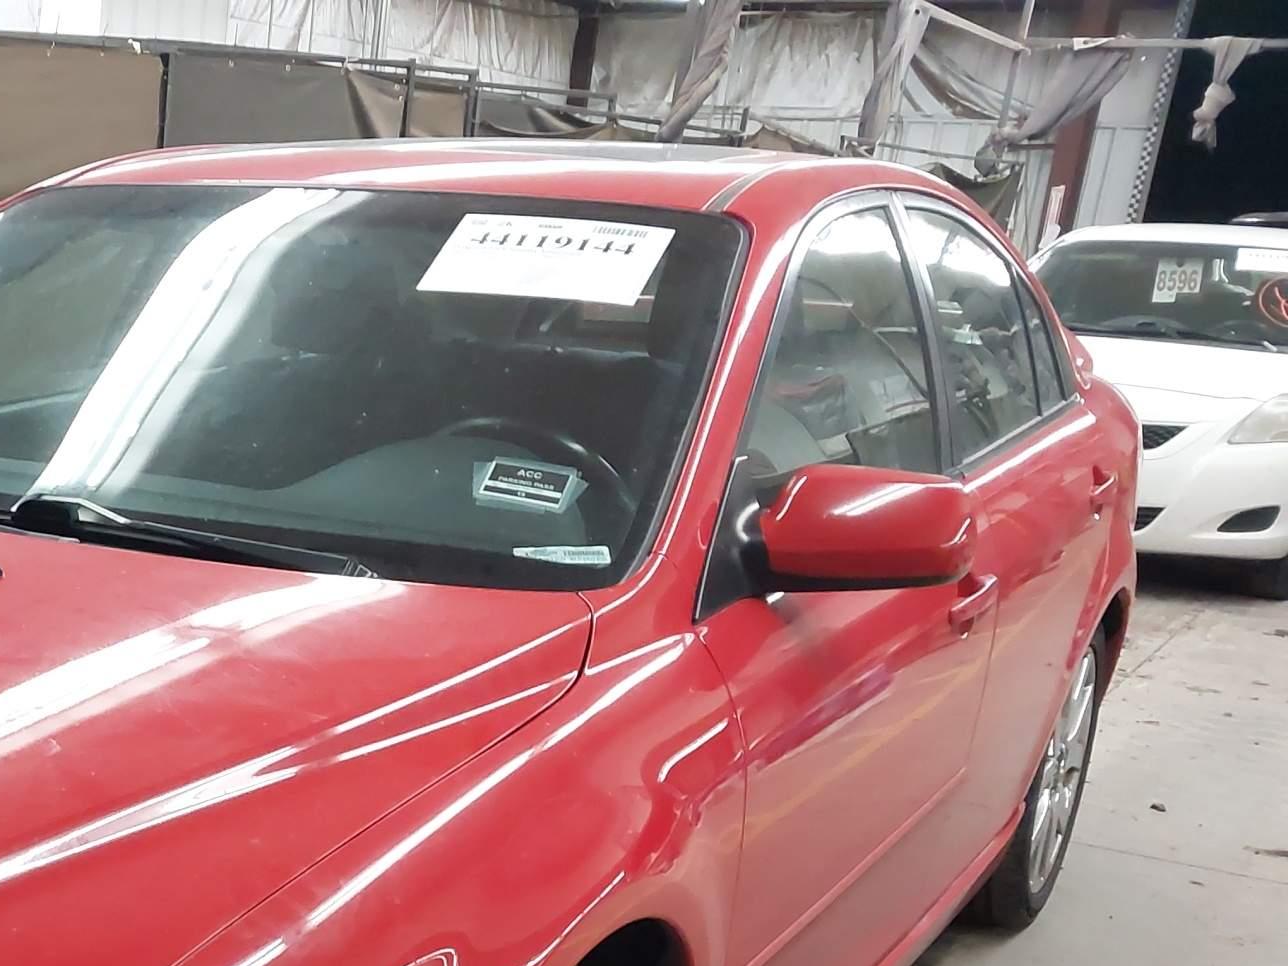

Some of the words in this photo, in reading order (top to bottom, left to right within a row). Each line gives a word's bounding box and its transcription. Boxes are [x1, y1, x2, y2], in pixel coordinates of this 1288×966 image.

[470, 231, 636, 256] 44119144
[1157, 270, 1198, 292] 8596
[517, 469, 543, 480] ACC
